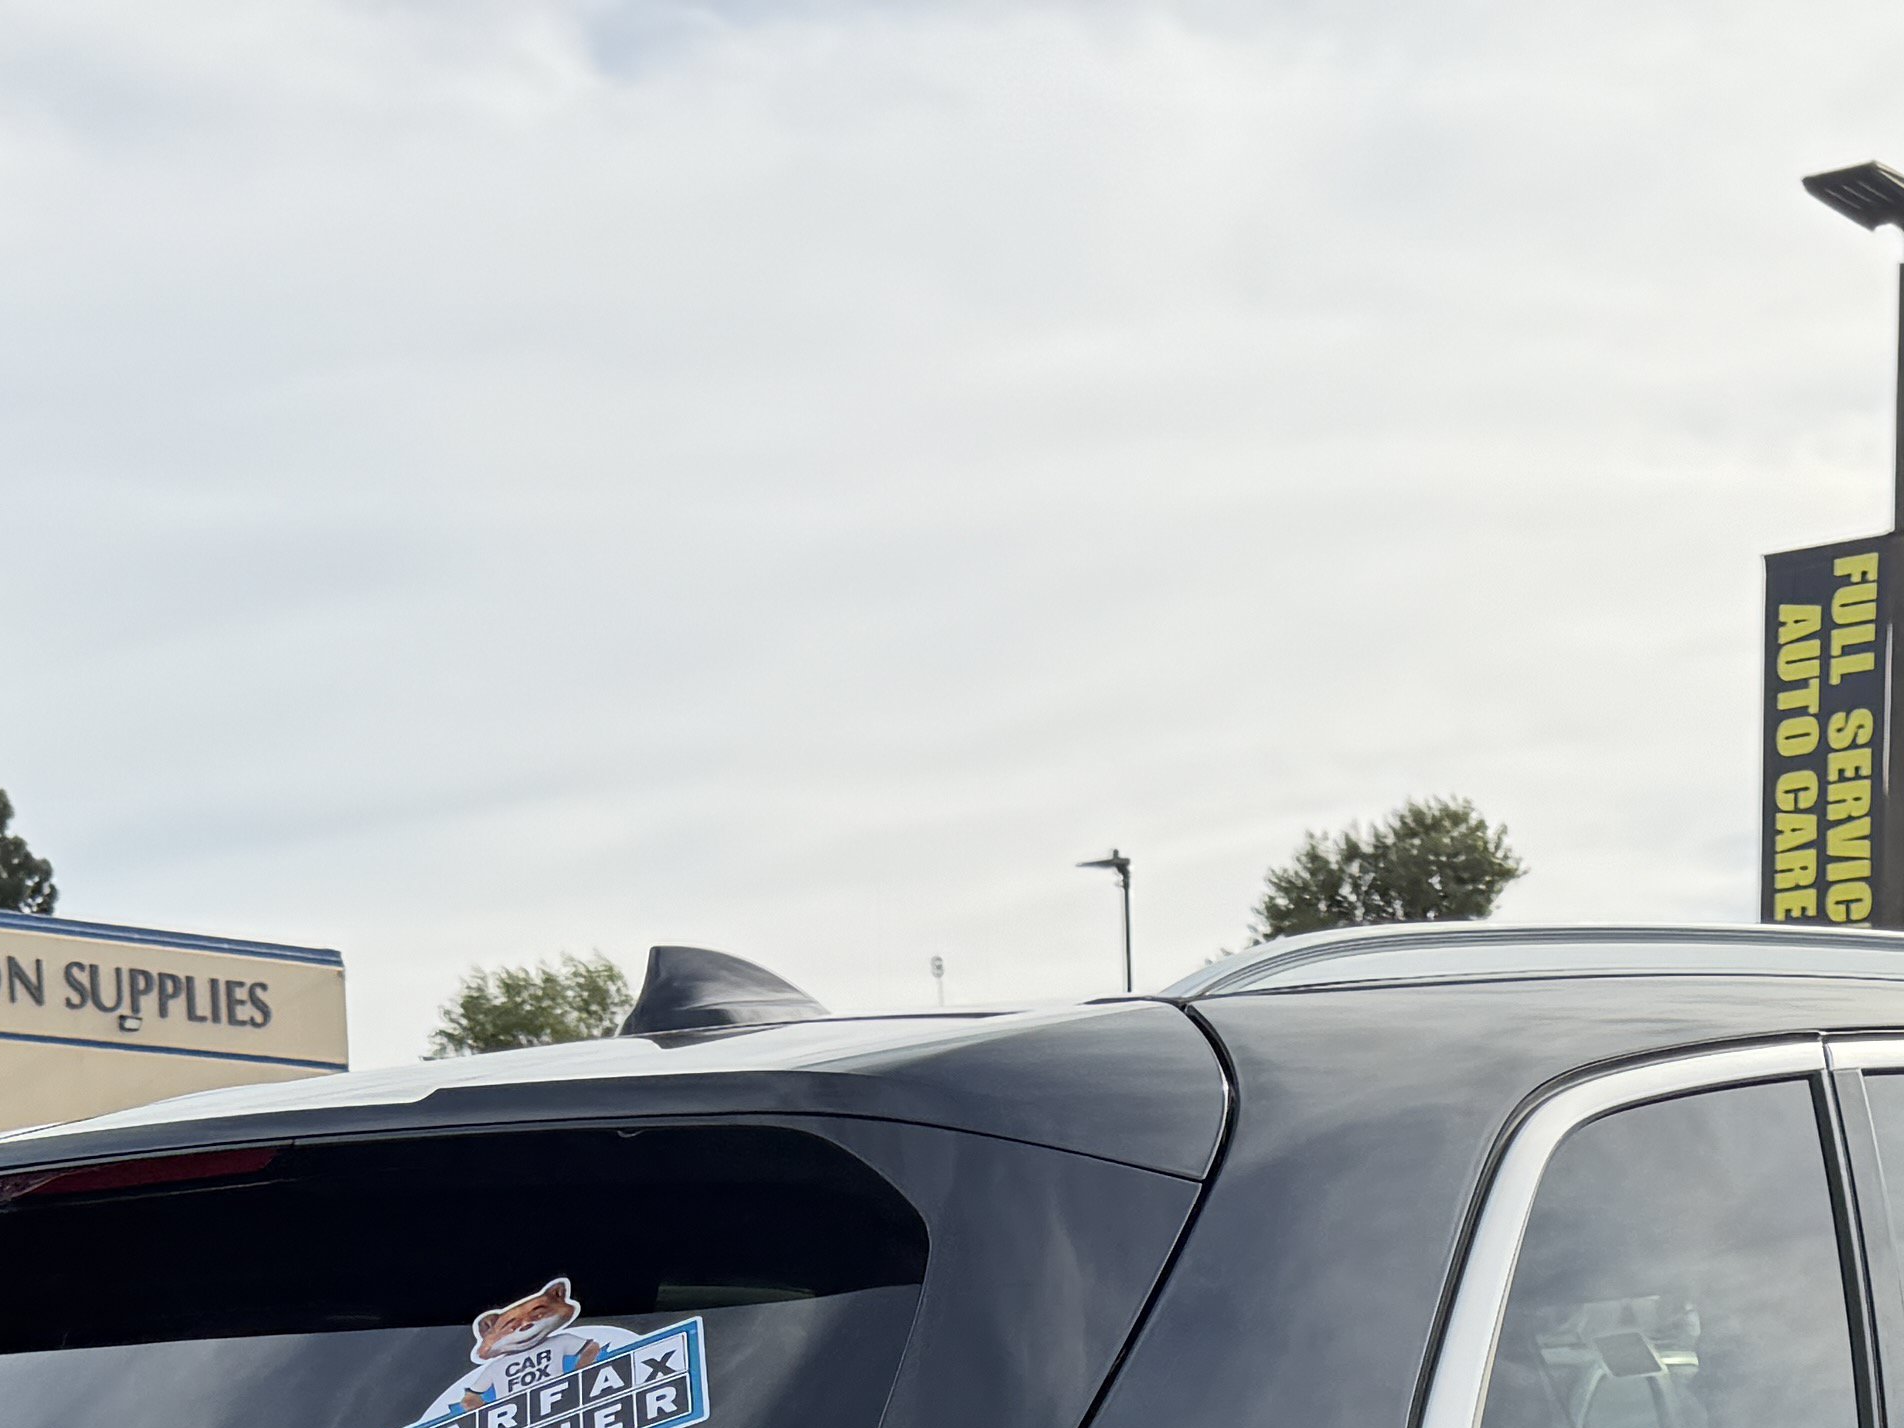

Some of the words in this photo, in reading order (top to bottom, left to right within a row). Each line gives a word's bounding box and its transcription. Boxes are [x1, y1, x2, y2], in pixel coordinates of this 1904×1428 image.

[1775, 604, 1822, 757] AUTO
[1829, 551, 1879, 685] FULL
[1773, 769, 1820, 921] CARE
[1825, 708, 1873, 929] SERVIC
[64, 960, 272, 1029] SUPPLIES
[505, 1349, 552, 1379] CAR
[508, 1365, 551, 1393] FOX
